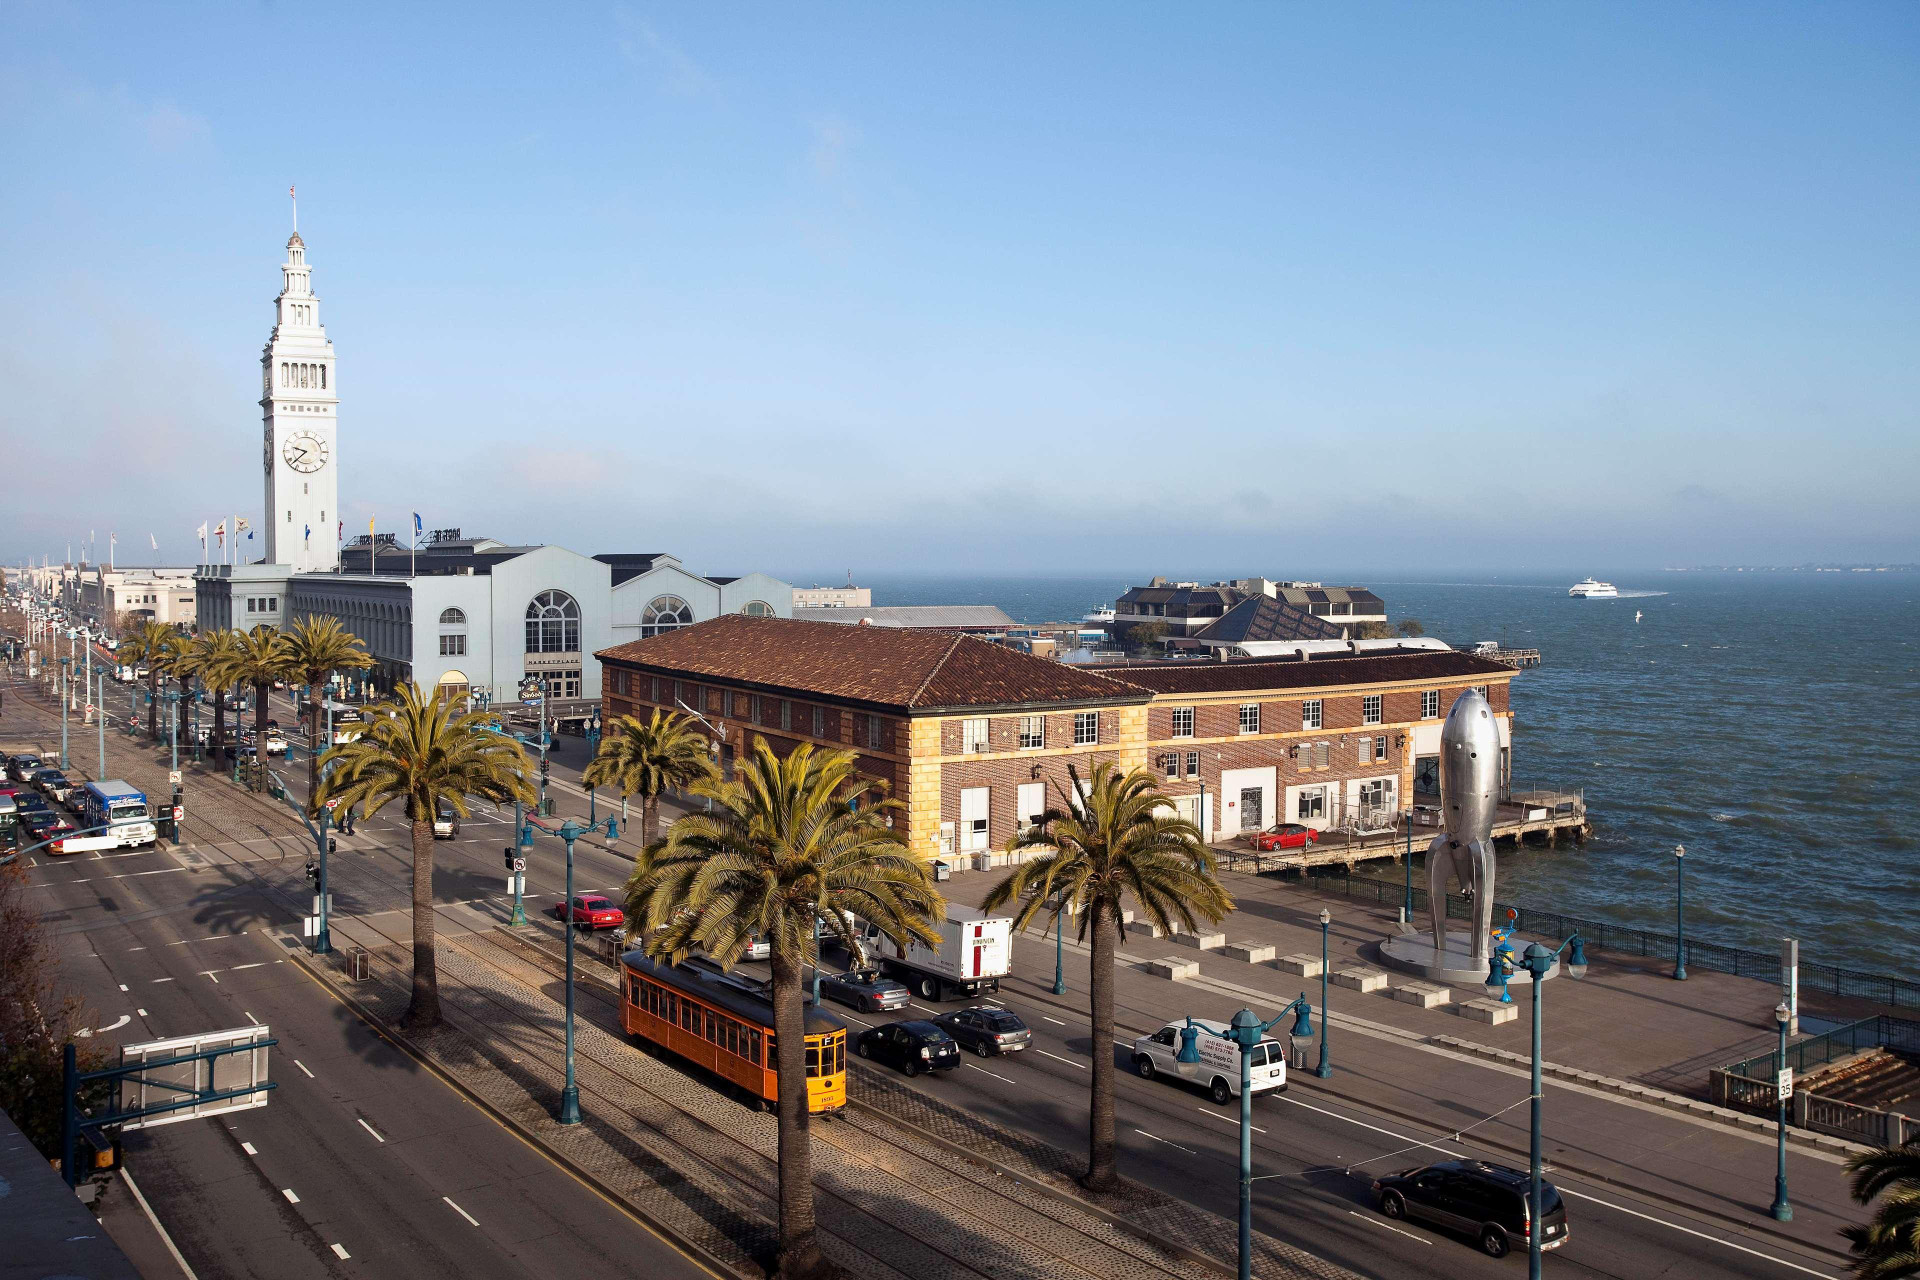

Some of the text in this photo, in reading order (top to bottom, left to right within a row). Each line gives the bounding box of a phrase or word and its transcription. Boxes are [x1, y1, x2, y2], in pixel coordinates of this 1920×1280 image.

[825, 1037, 831, 1045] F
[1213, 1053, 1227, 1062] Supply
[1781, 1084, 1790, 1096] 35
